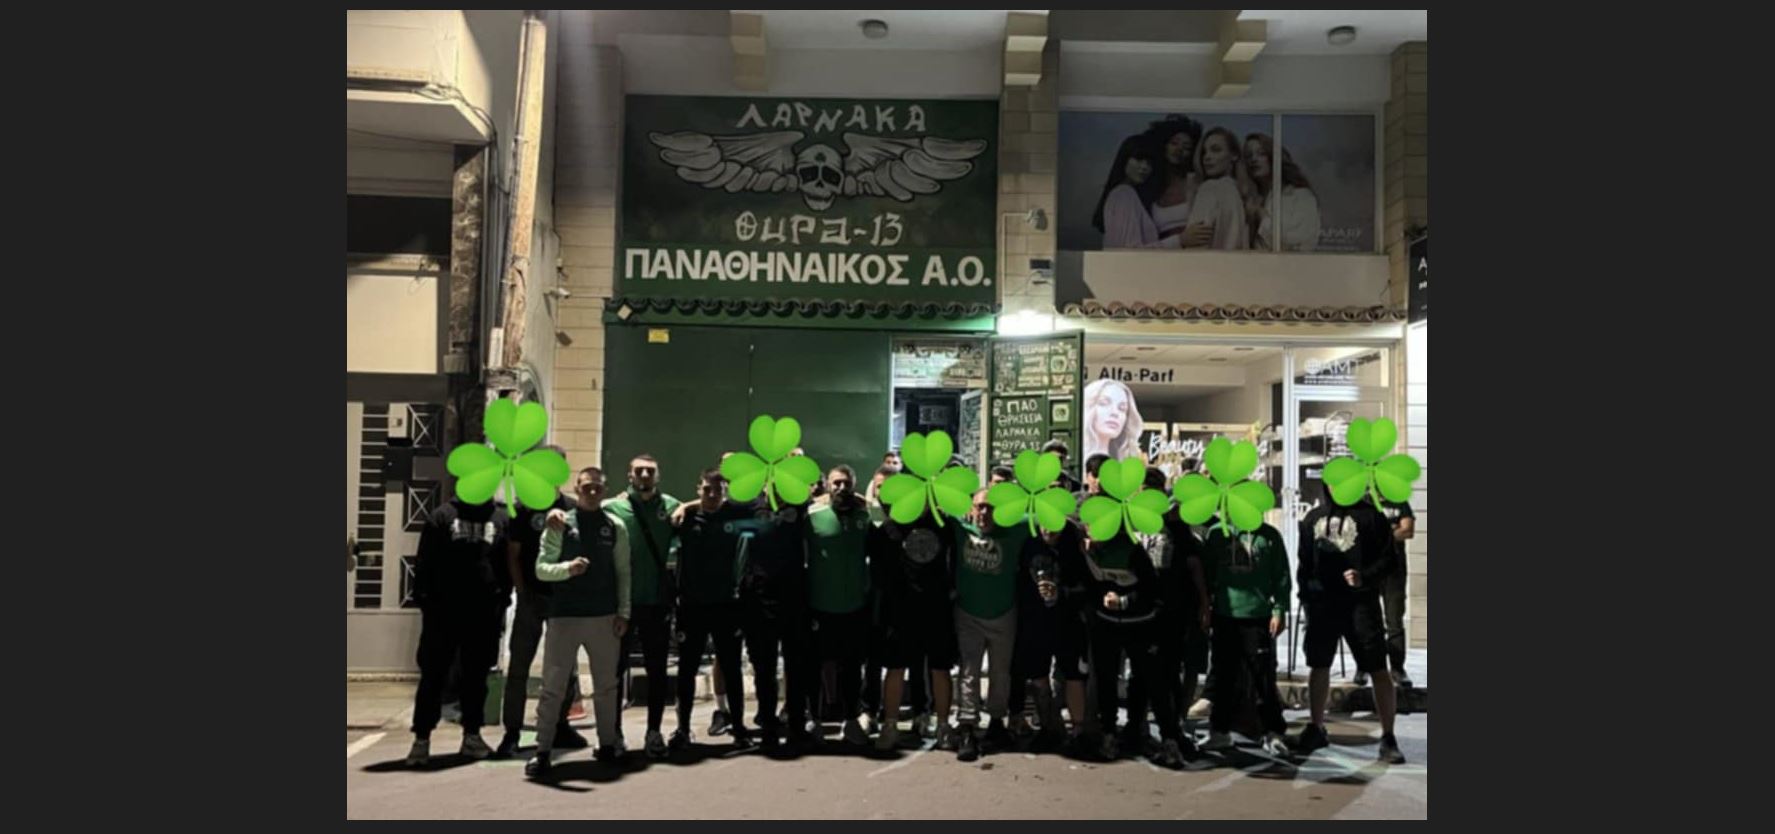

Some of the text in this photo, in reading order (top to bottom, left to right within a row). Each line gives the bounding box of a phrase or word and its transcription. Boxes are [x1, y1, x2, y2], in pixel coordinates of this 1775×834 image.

[736, 102, 926, 133] ΛΑΡΝΑΚΑ
[625, 248, 992, 287] ΠΑΝΑΘΗΝΑΙΚΟΣ Α.Ο.
[1007, 399, 1038, 413] ΠΑΟ
